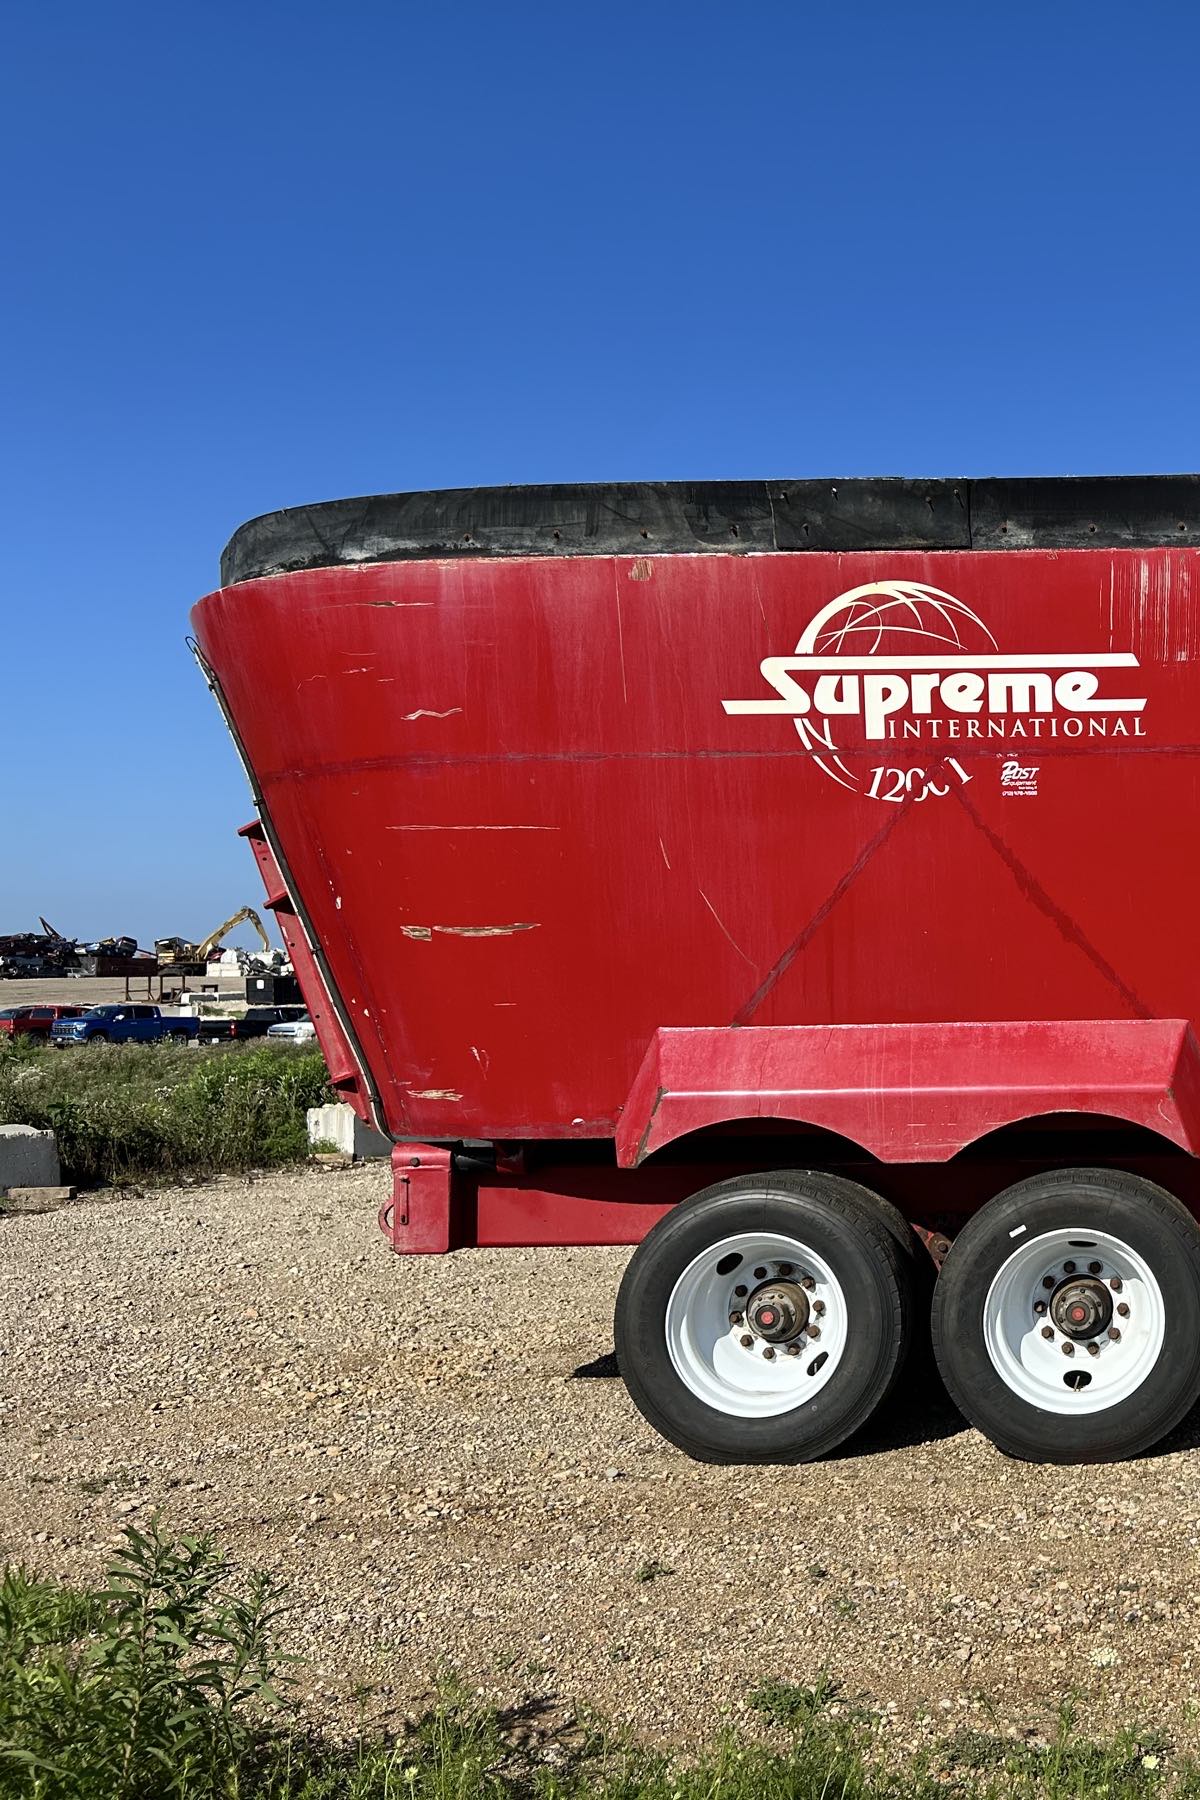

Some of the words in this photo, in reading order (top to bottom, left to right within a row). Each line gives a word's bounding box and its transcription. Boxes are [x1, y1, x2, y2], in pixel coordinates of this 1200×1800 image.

[721, 652, 1147, 739] Supreme
[888, 717, 1147, 738] INTERNATIONAL
[1000, 760, 1040, 781] POST
